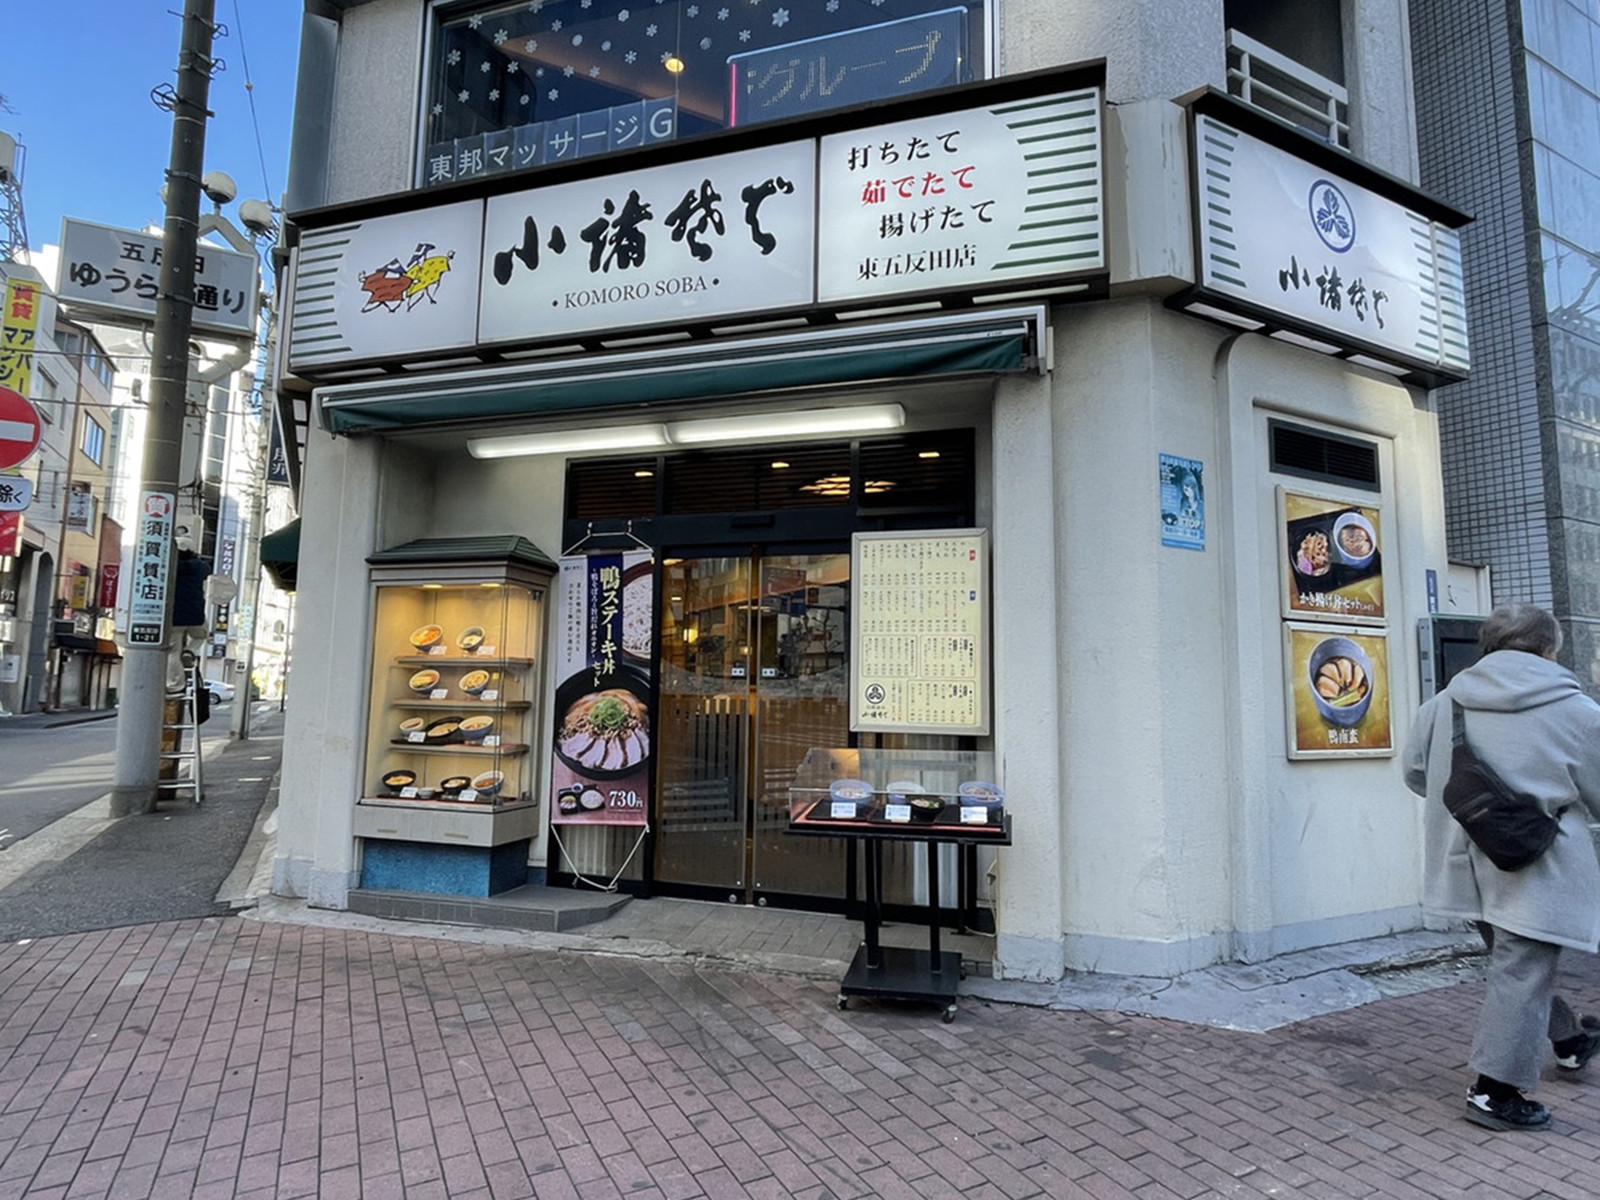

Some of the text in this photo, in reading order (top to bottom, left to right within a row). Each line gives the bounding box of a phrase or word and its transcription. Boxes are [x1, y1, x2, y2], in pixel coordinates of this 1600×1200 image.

[429, 108, 673, 181] 東邦マッサージG
[847, 131, 961, 171] 打ちたて
[861, 165, 976, 207] 茹でたて
[879, 200, 996, 239] 揚げたて
[856, 244, 977, 281] 東五反田店
[70, 262, 245, 315] ゆうら通り
[565, 275, 708, 309] KOMORO SOBA
[600, 565, 620, 675] 鴨ステーキ丼
